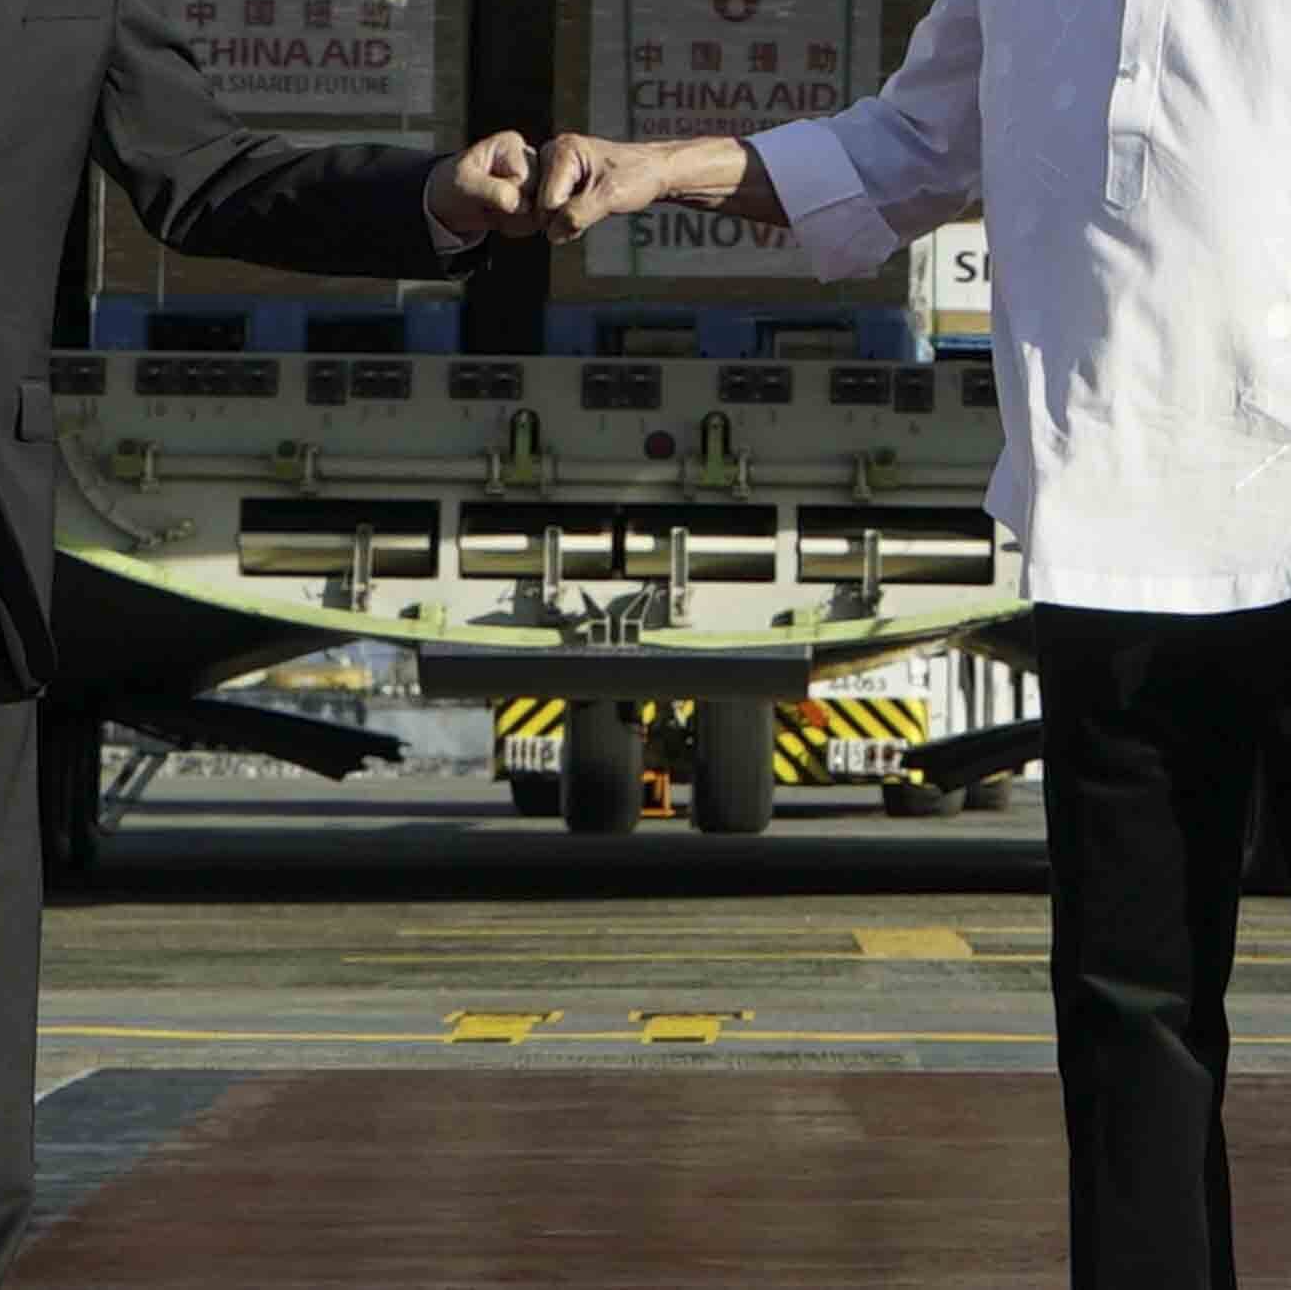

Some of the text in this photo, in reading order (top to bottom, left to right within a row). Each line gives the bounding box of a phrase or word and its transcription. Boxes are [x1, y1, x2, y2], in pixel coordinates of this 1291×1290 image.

[319, 37, 393, 70] AID
[315, 75, 390, 96] FUTURE
[634, 79, 838, 112] CHINA AID
